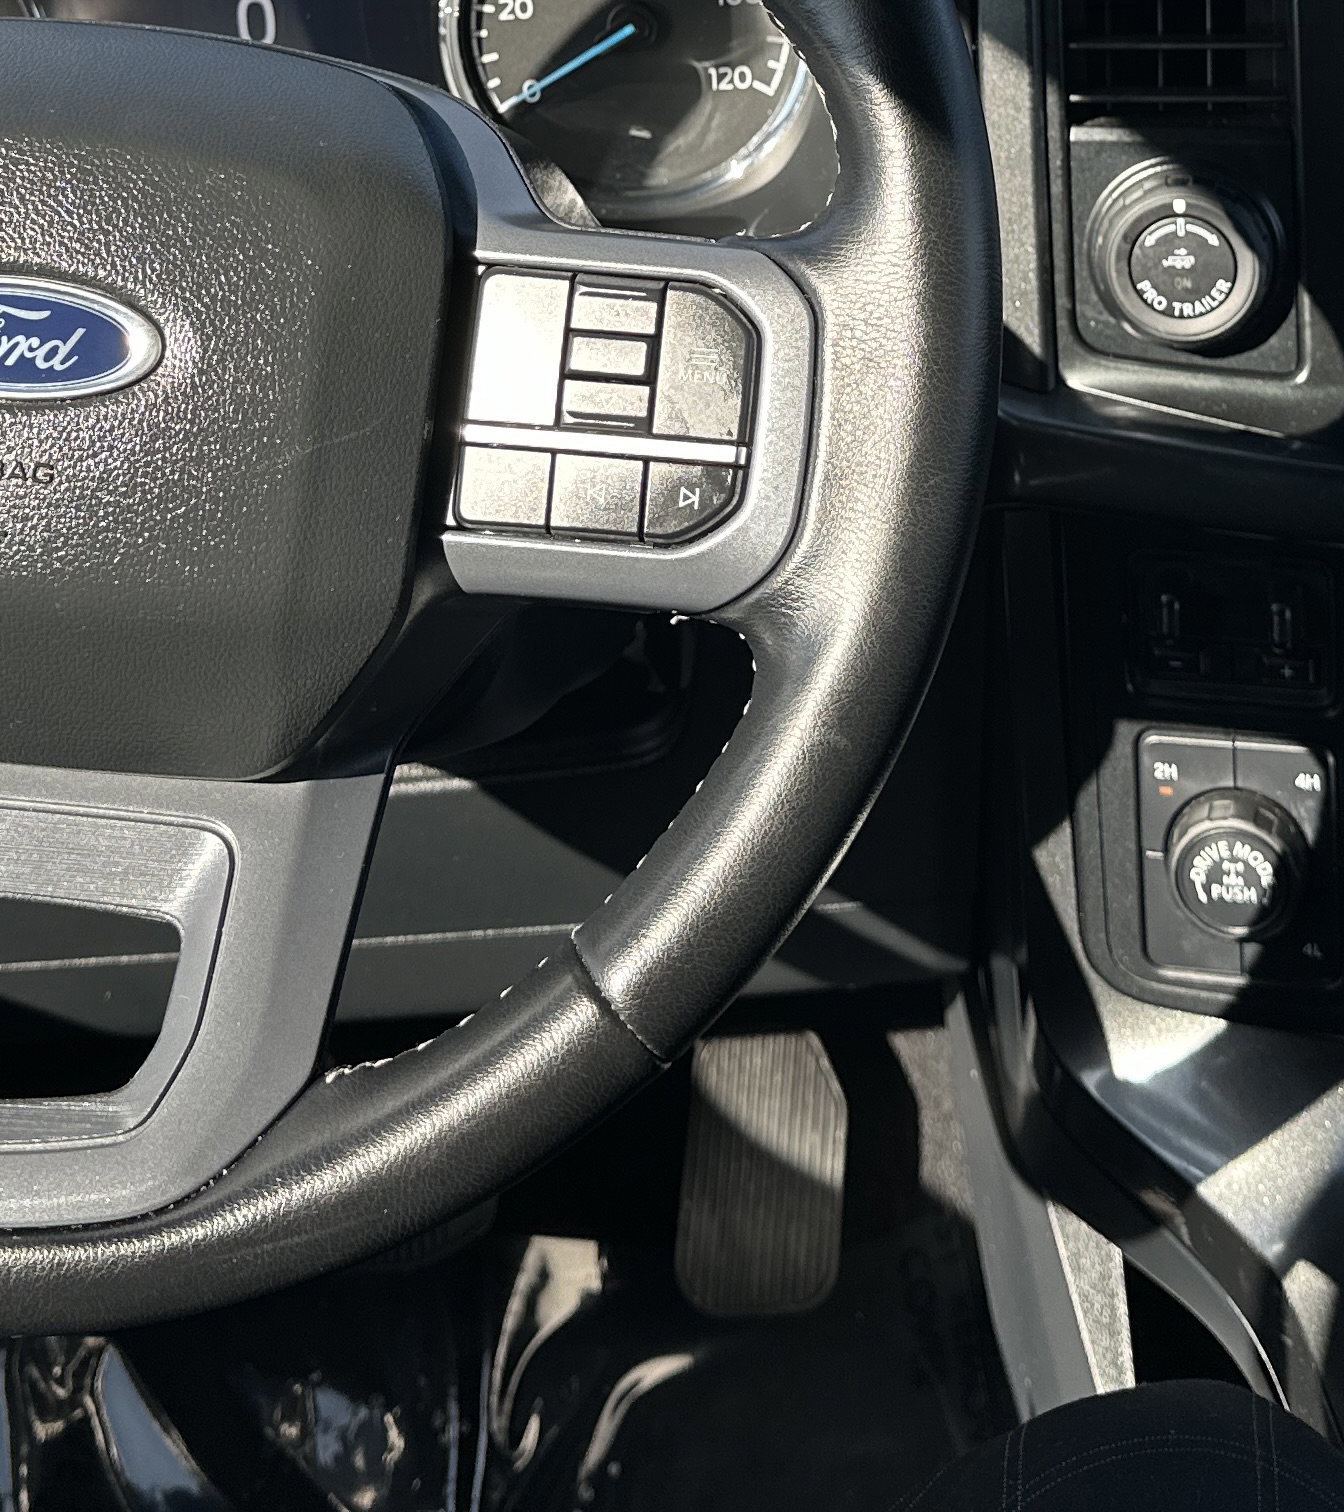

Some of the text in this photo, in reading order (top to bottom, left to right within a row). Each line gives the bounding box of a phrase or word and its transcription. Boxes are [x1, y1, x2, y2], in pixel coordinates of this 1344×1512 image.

[707, 65, 753, 91] 120
[520, 77, 542, 104] 0
[1136, 278, 1233, 317] PRO TRAILER
[1153, 761, 1179, 781] 2H
[1294, 773, 1322, 792] 4H
[1189, 840, 1276, 887] DRIVE MODE
[1209, 884, 1258, 903] PUSH
[1301, 942, 1322, 959] 4L
